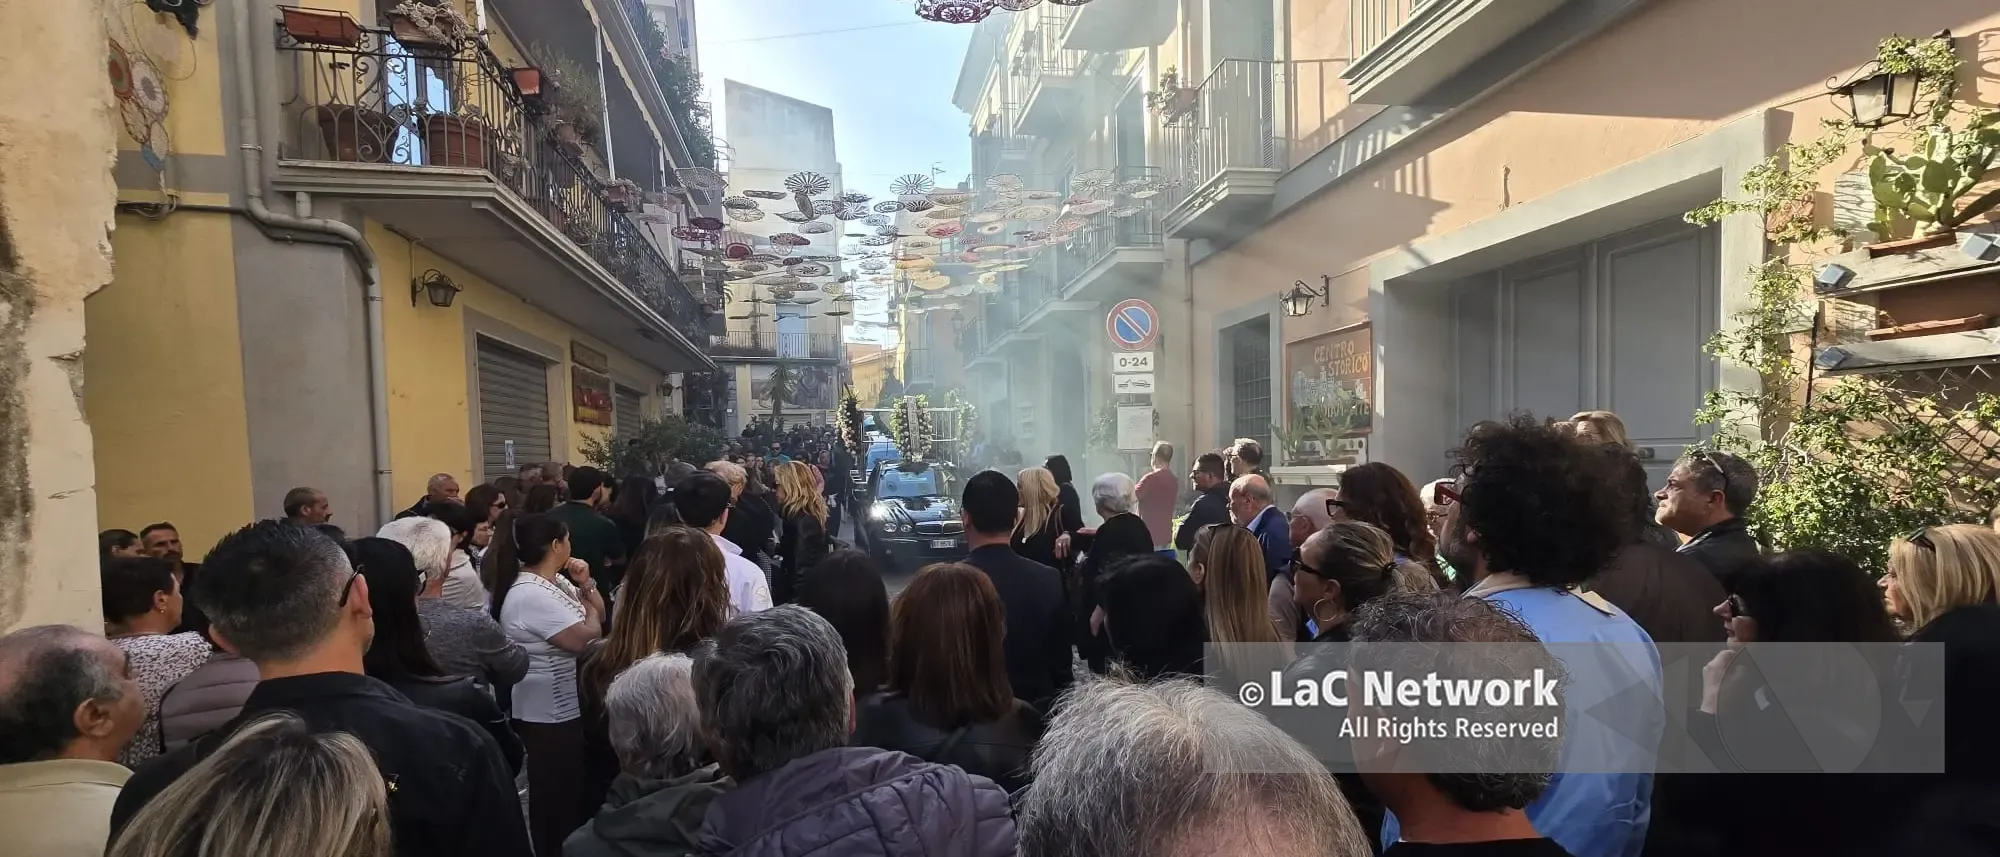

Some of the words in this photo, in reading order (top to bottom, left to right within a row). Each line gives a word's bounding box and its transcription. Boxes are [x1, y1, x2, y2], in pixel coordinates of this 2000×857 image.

[1119, 356, 1148, 367] 0-24
[1314, 340, 1355, 363] CENTRO
[1328, 354, 1369, 377] STORICO
